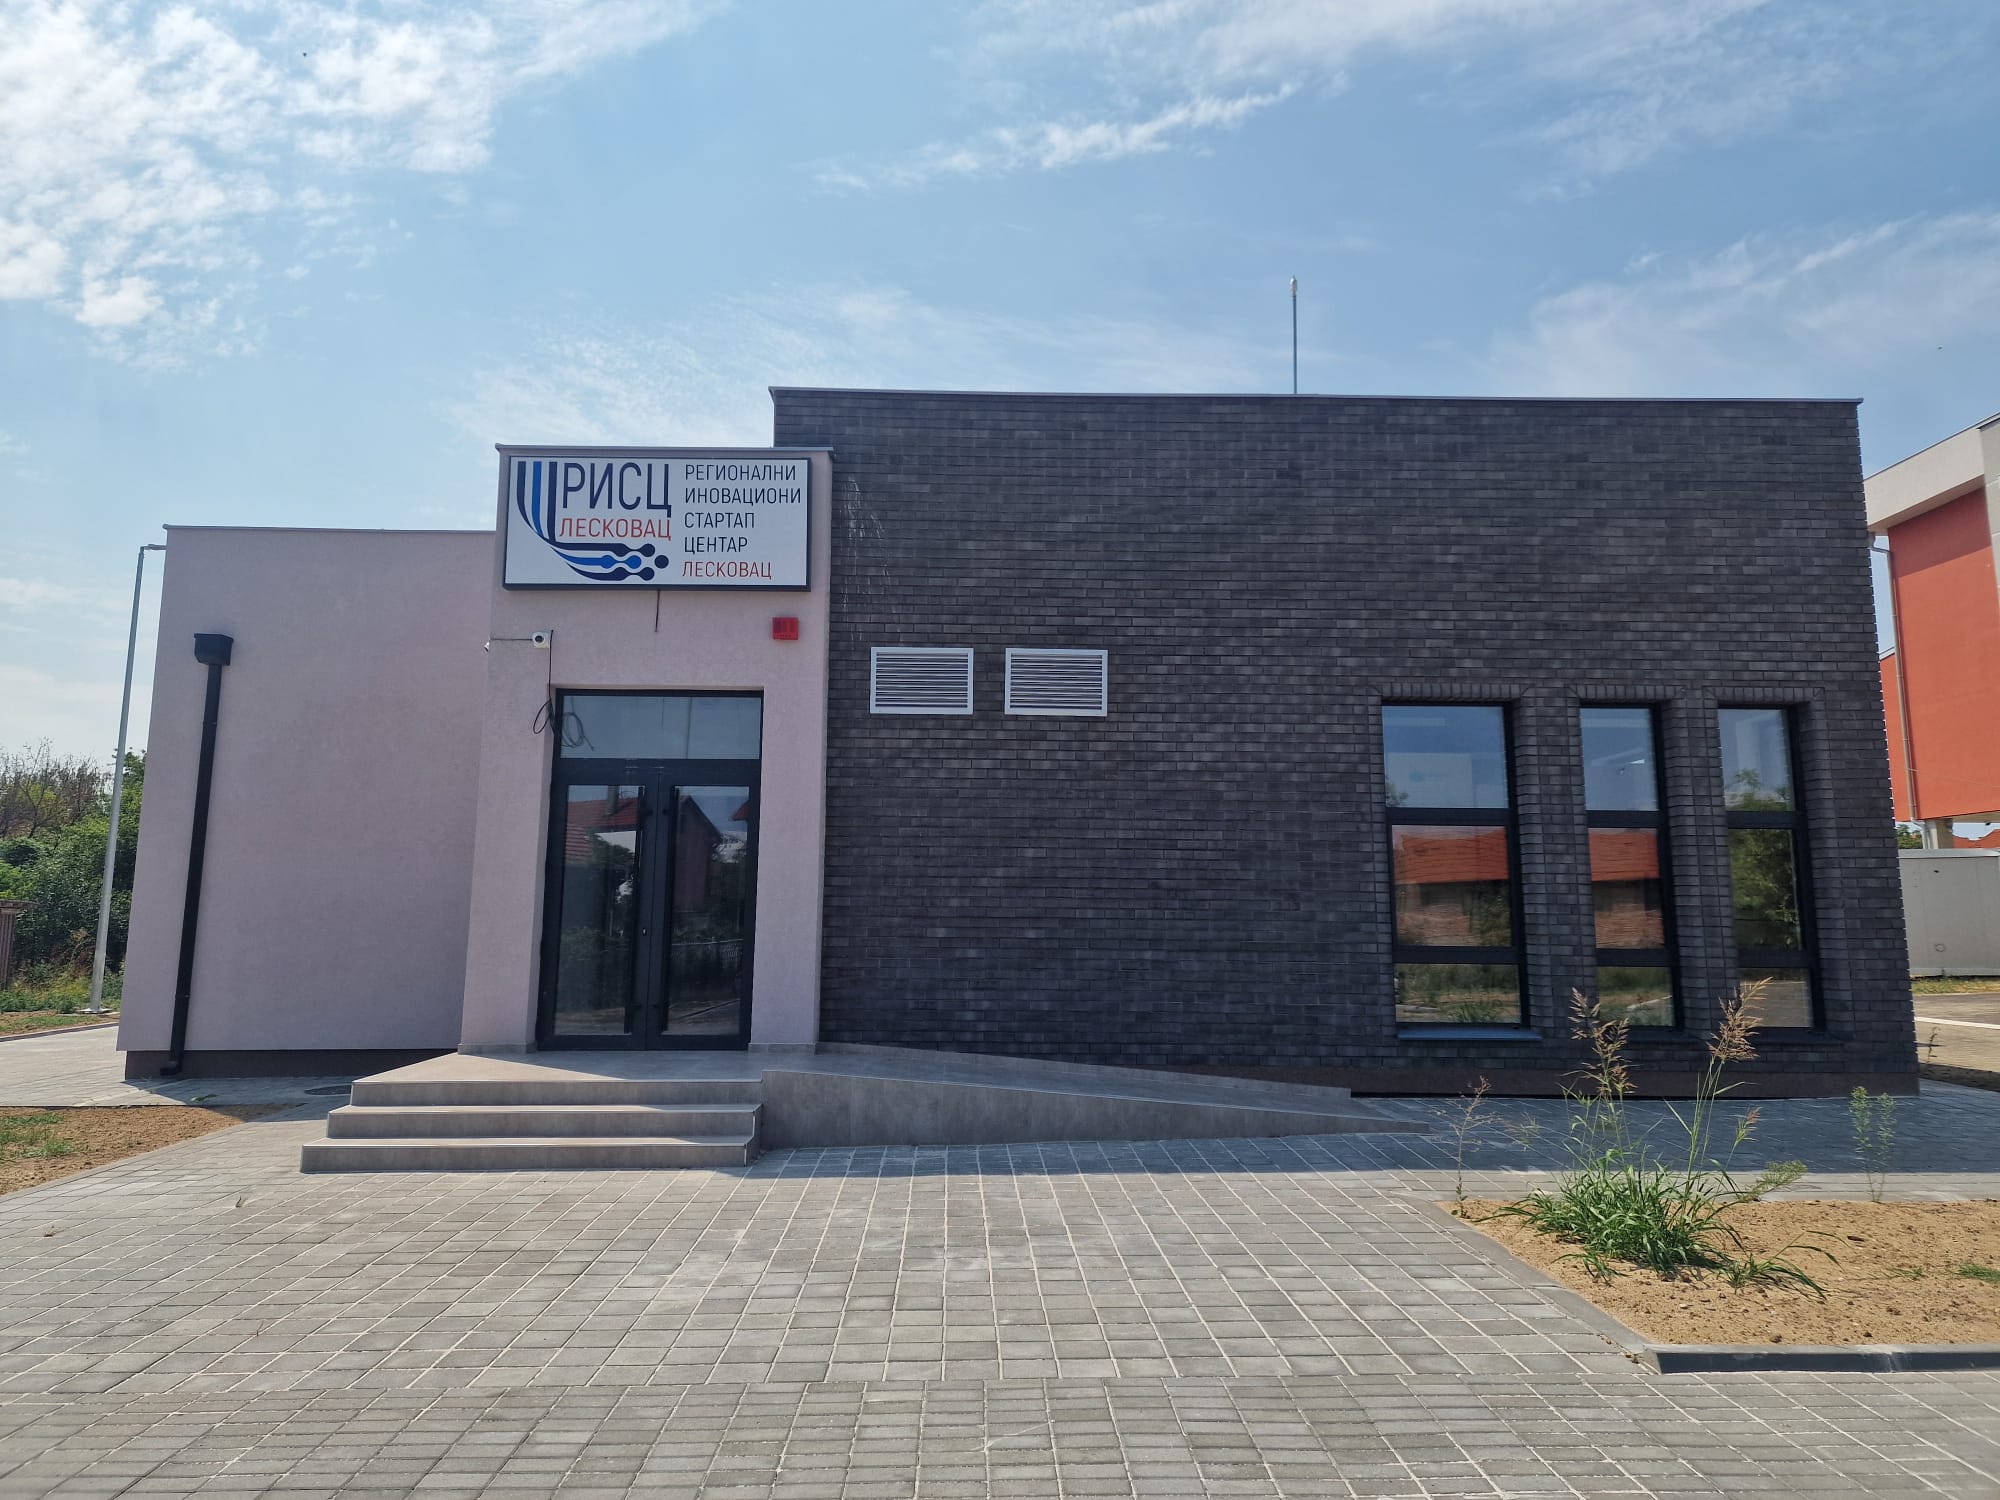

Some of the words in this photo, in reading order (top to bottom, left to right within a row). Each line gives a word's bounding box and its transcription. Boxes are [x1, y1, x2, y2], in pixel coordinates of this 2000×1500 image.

[685, 464, 796, 481] РЕГИОНАЛНИ
[563, 462, 672, 518] РИСЦ
[685, 487, 801, 506] ИНОВАЦИОНИ
[559, 518, 672, 541] ЛЕСКОВАЦ
[684, 512, 755, 529] СТАРТАП
[684, 536, 748, 555] ЦЕНТАР
[682, 561, 772, 580] ЛЕСКОВАЦ
